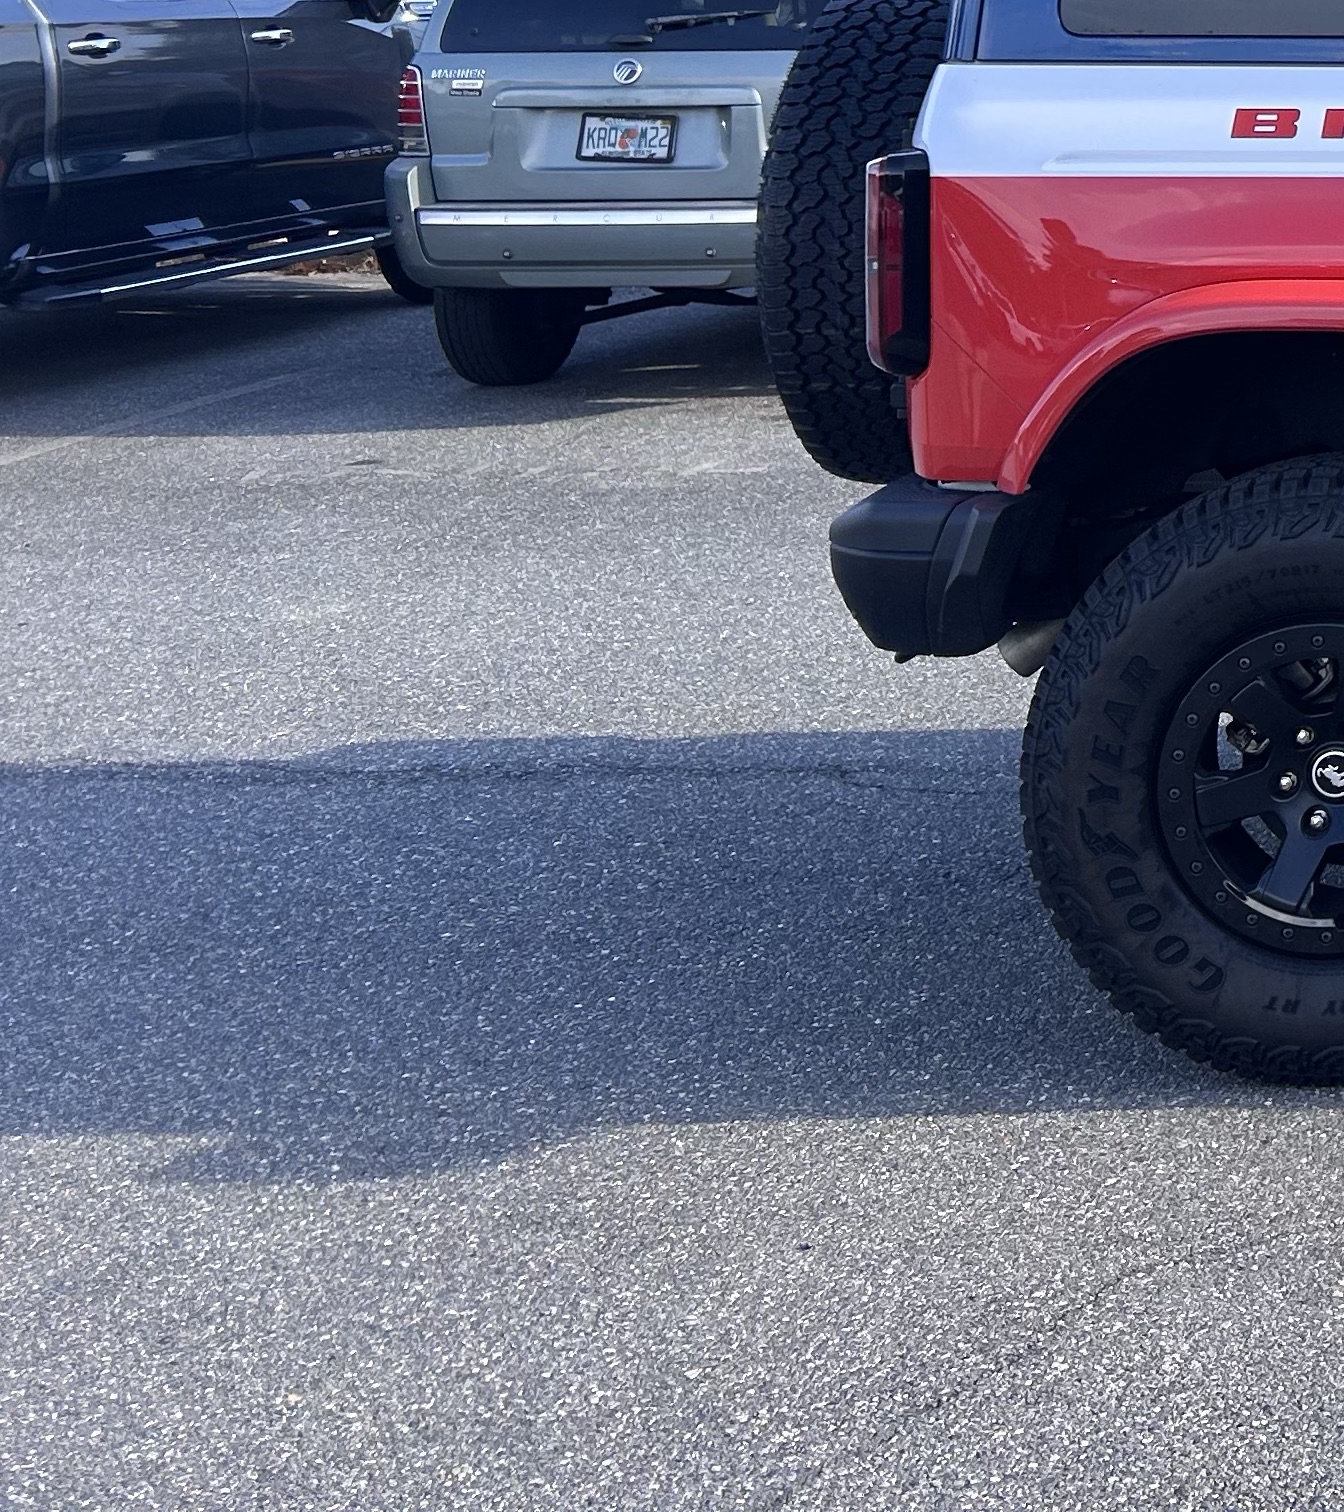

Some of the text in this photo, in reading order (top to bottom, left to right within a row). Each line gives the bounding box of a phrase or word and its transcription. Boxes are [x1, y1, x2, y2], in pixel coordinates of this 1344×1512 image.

[431, 68, 487, 79] MARINER
[638, 125, 669, 149] M22
[332, 144, 394, 161] SIERRA
[451, 213, 716, 224] MERCUR
